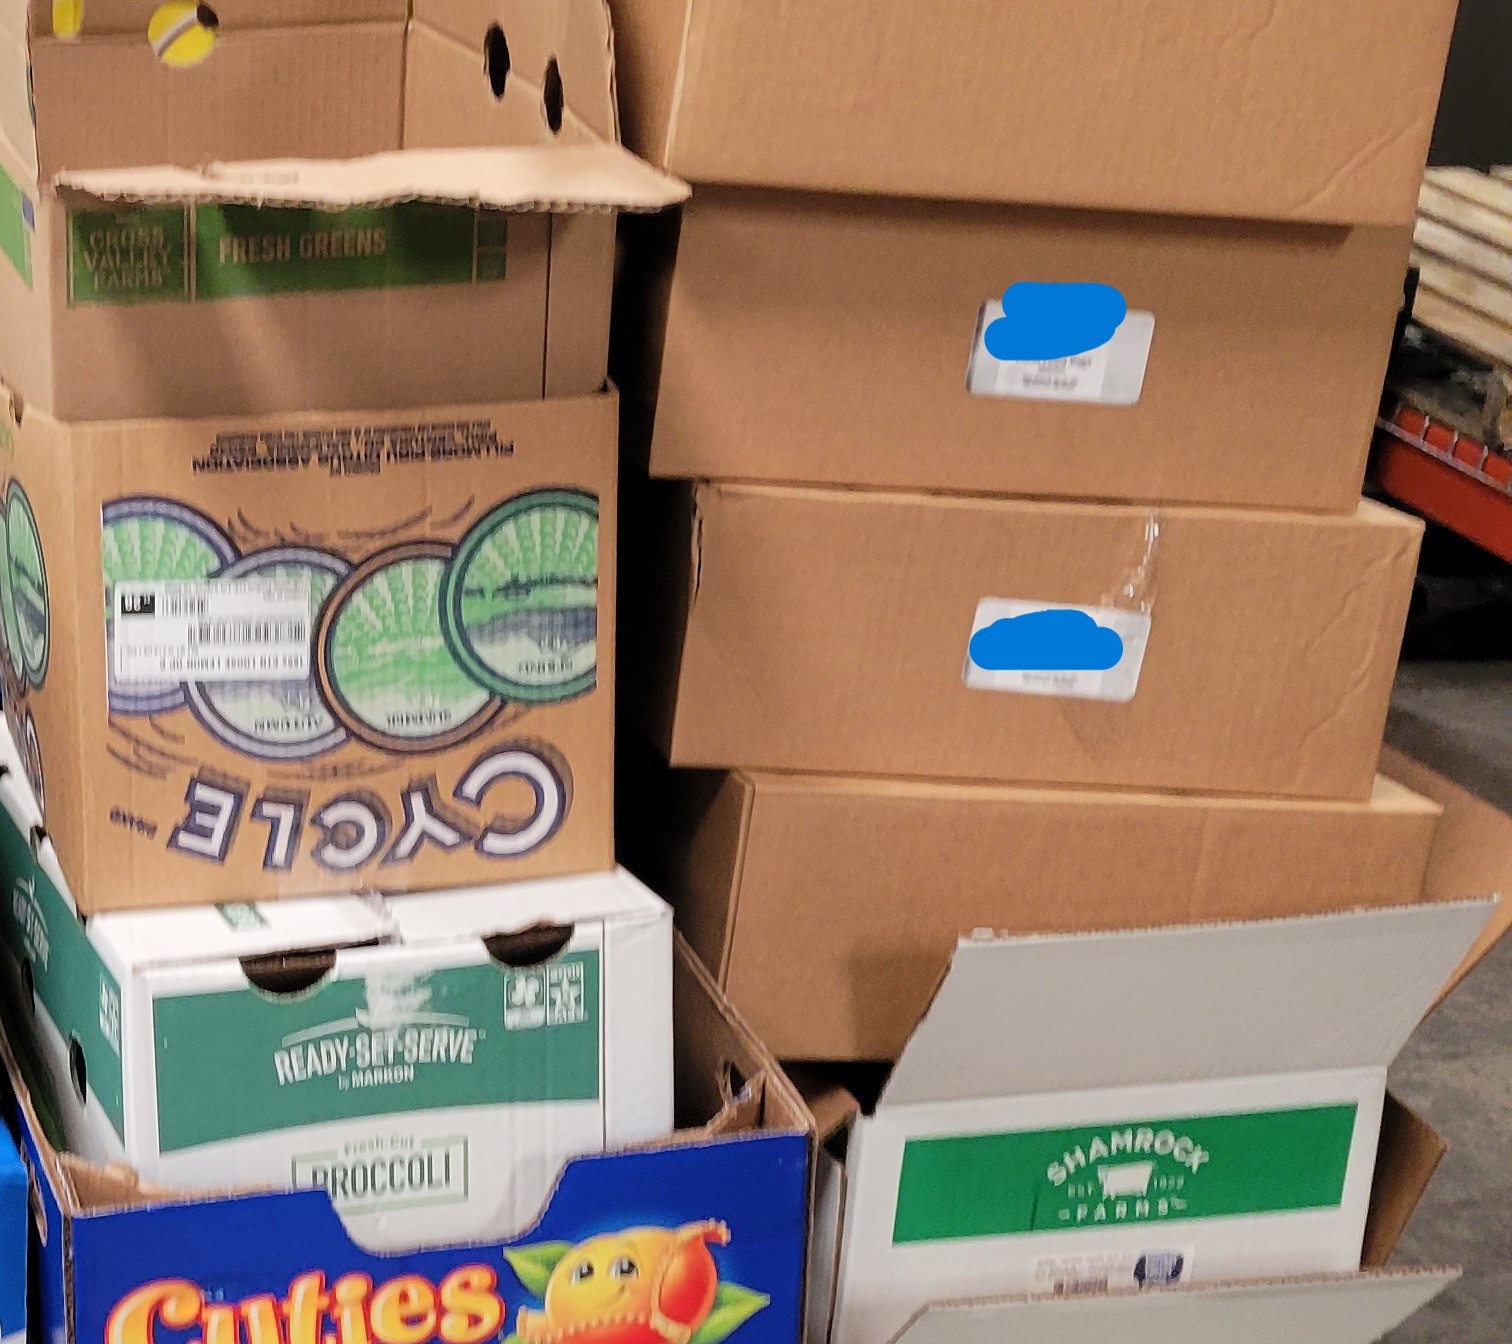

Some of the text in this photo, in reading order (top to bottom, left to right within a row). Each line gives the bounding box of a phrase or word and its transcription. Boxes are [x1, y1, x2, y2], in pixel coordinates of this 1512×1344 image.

[89, 225, 165, 252] CROSS
[218, 227, 387, 267] FRESH GREENS
[83, 247, 171, 271] VALLEY
[191, 454, 312, 477] ASSOCIATION
[168, 748, 571, 867] CYCLE
[351, 1063, 414, 1090] MARKON
[1046, 1126, 1210, 1187] SHAMROCK
[1075, 1196, 1169, 1223] FARMS
